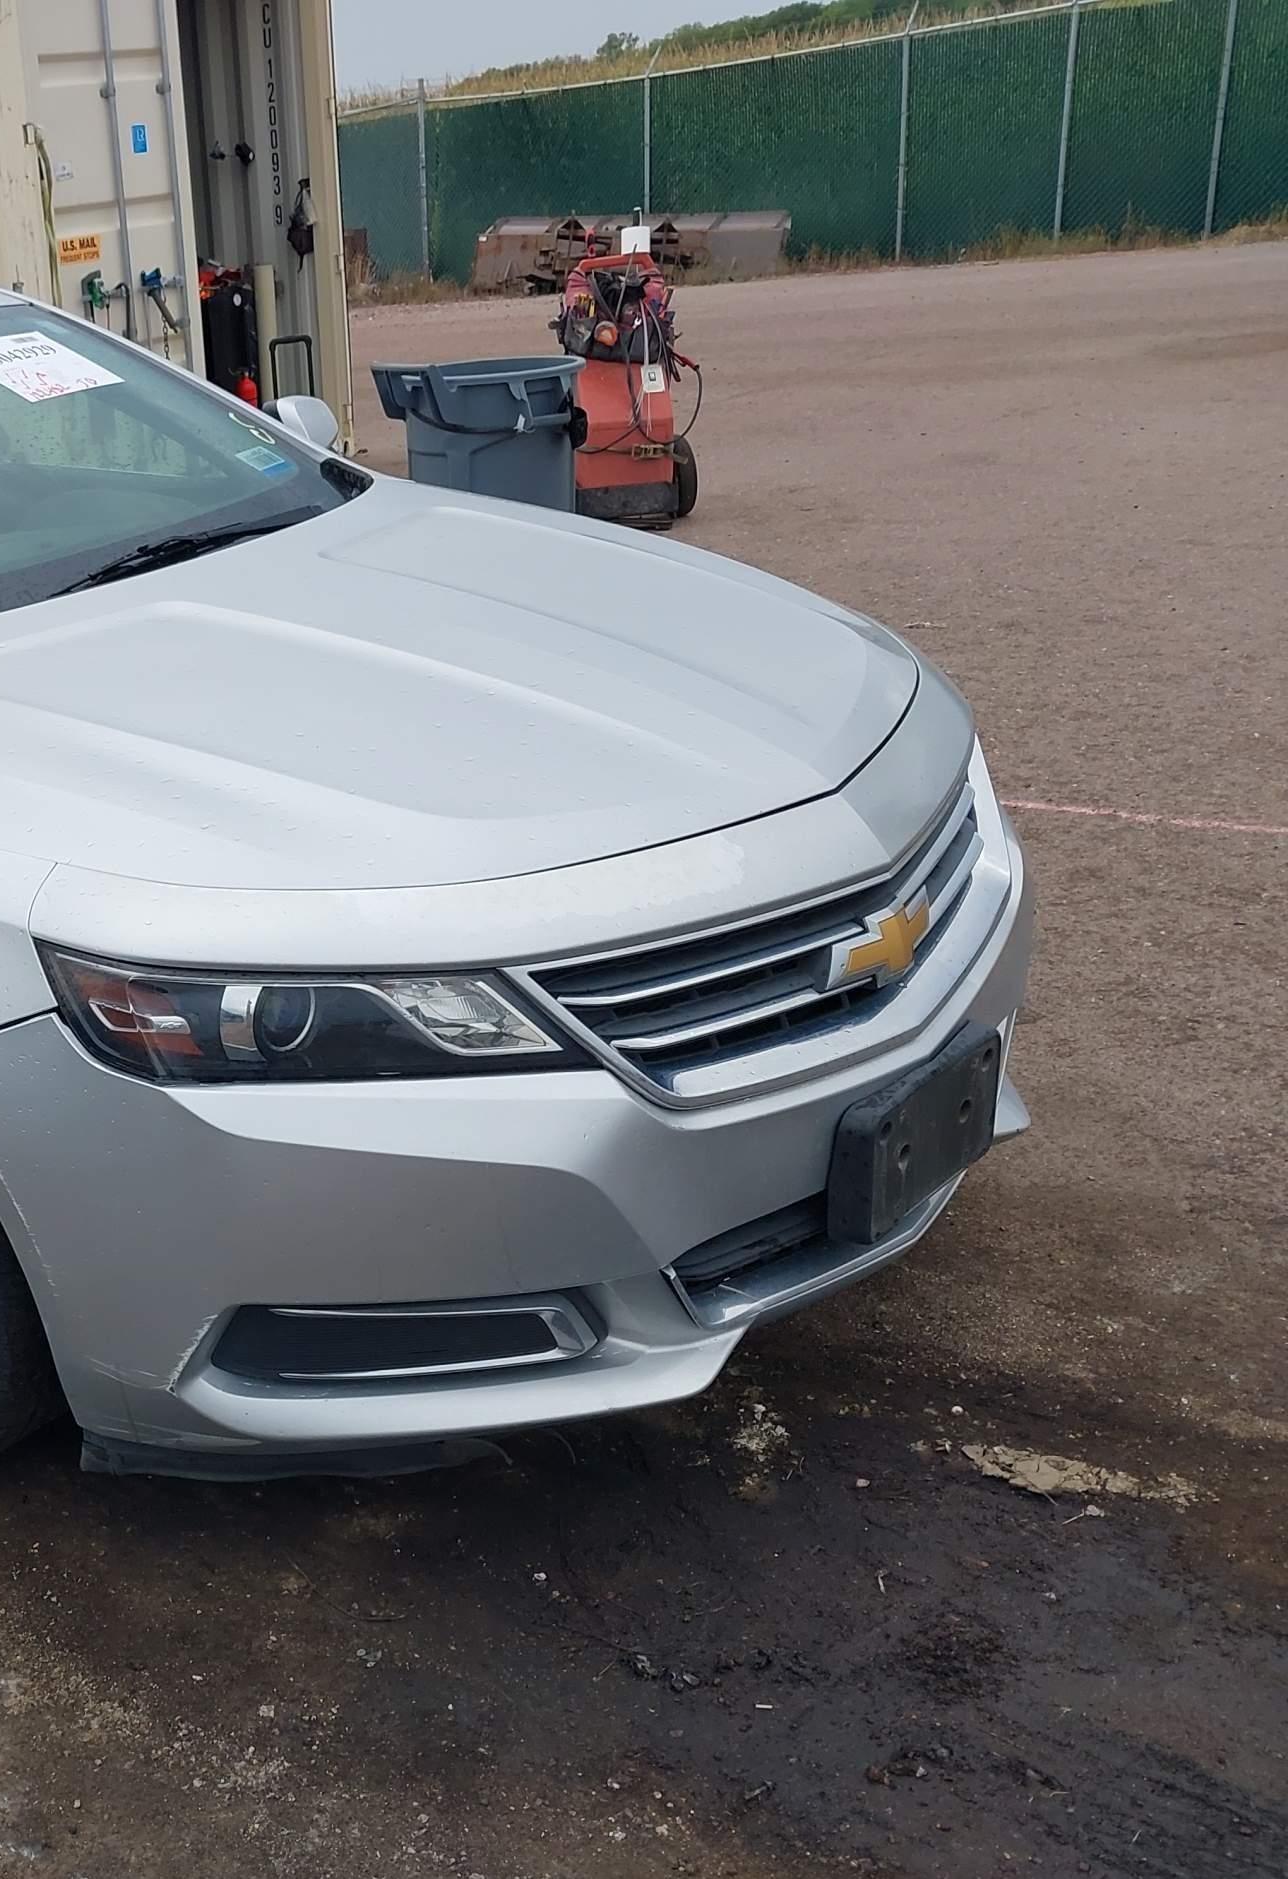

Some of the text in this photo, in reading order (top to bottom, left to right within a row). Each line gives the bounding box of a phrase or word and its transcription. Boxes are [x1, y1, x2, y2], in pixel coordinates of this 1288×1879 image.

[268, 58, 281, 196] 120093
[62, 236, 97, 252] U.S. MAIL
